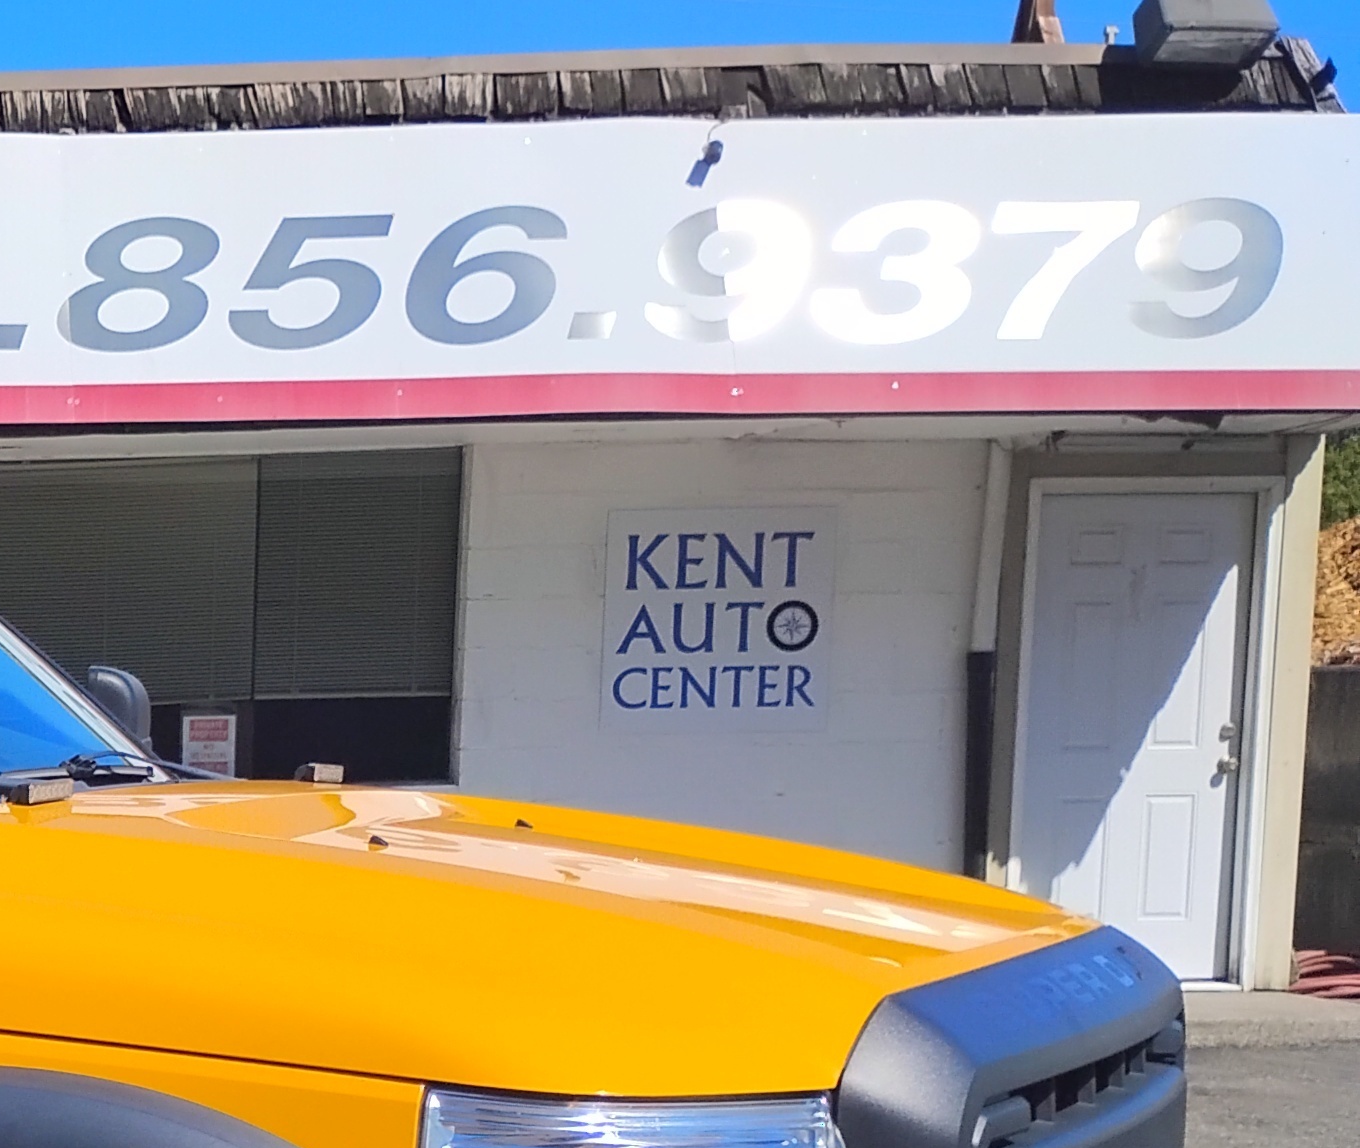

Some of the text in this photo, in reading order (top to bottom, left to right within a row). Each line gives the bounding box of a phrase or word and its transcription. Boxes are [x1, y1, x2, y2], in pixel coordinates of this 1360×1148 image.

[625, 532, 816, 590] KENT
[615, 600, 820, 654] AUTO
[612, 665, 816, 710] CENTER
